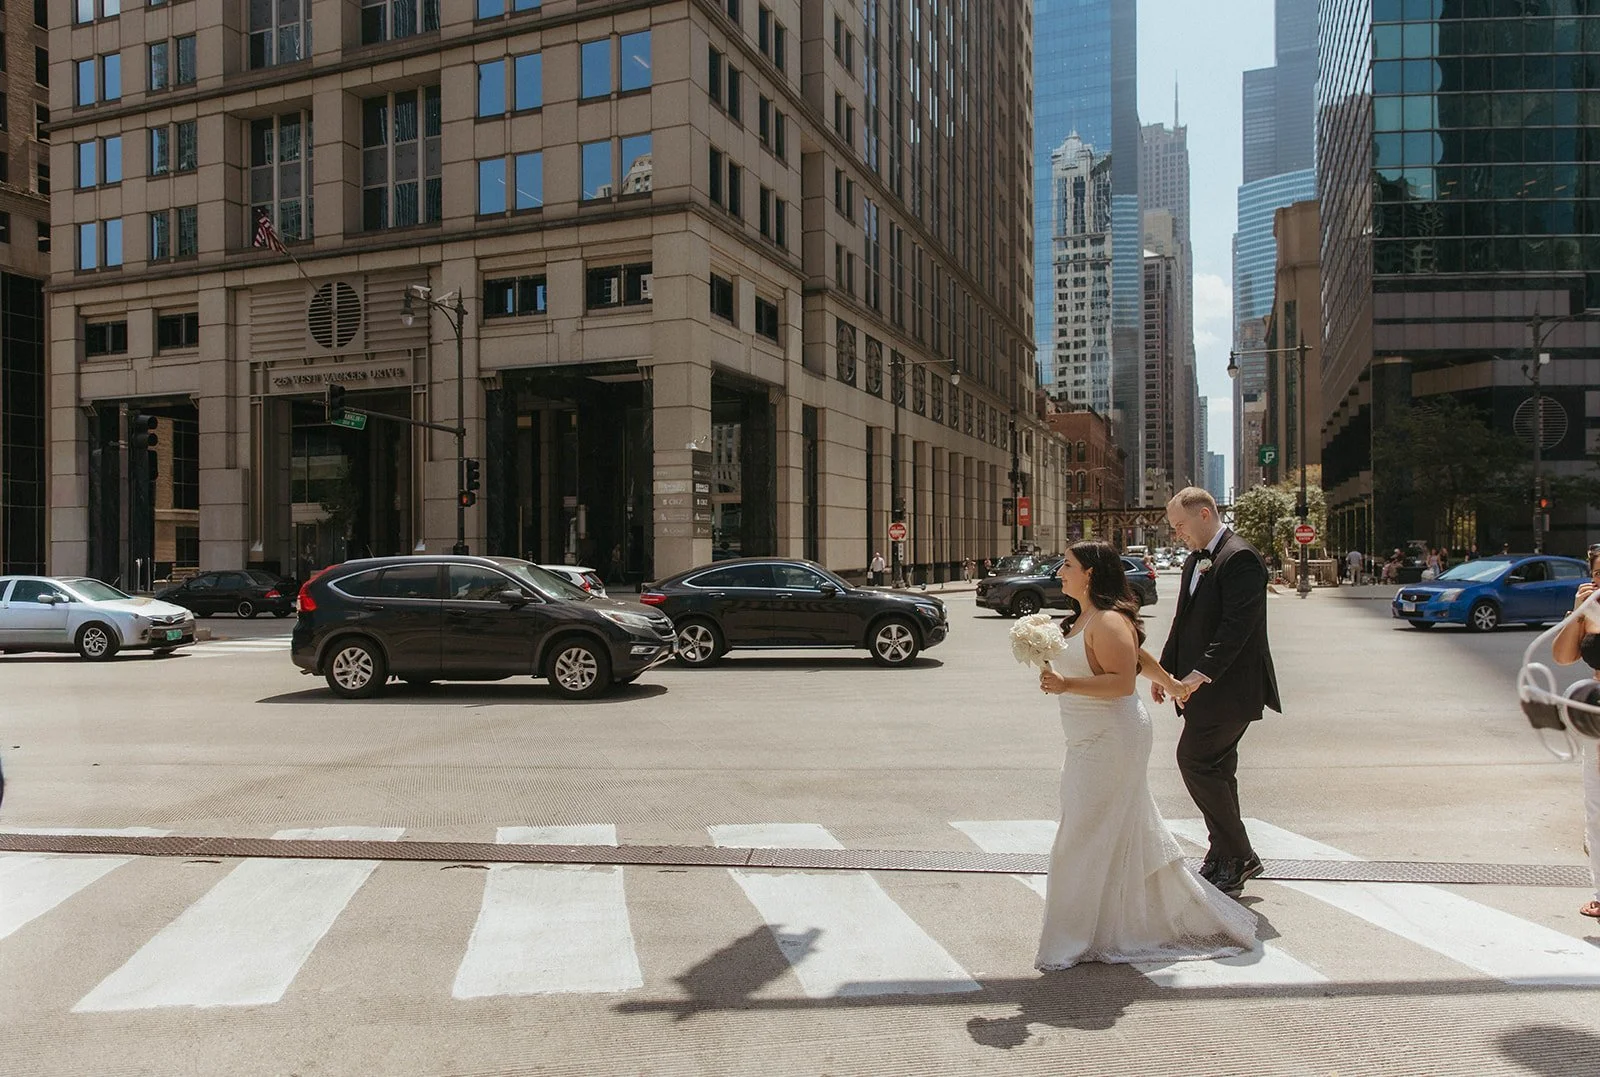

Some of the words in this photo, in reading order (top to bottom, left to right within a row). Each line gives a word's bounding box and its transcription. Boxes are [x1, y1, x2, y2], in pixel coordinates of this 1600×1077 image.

[293, 374, 318, 384] WEST
[323, 370, 366, 381] WACKER
[370, 367, 405, 379] DRIVE
